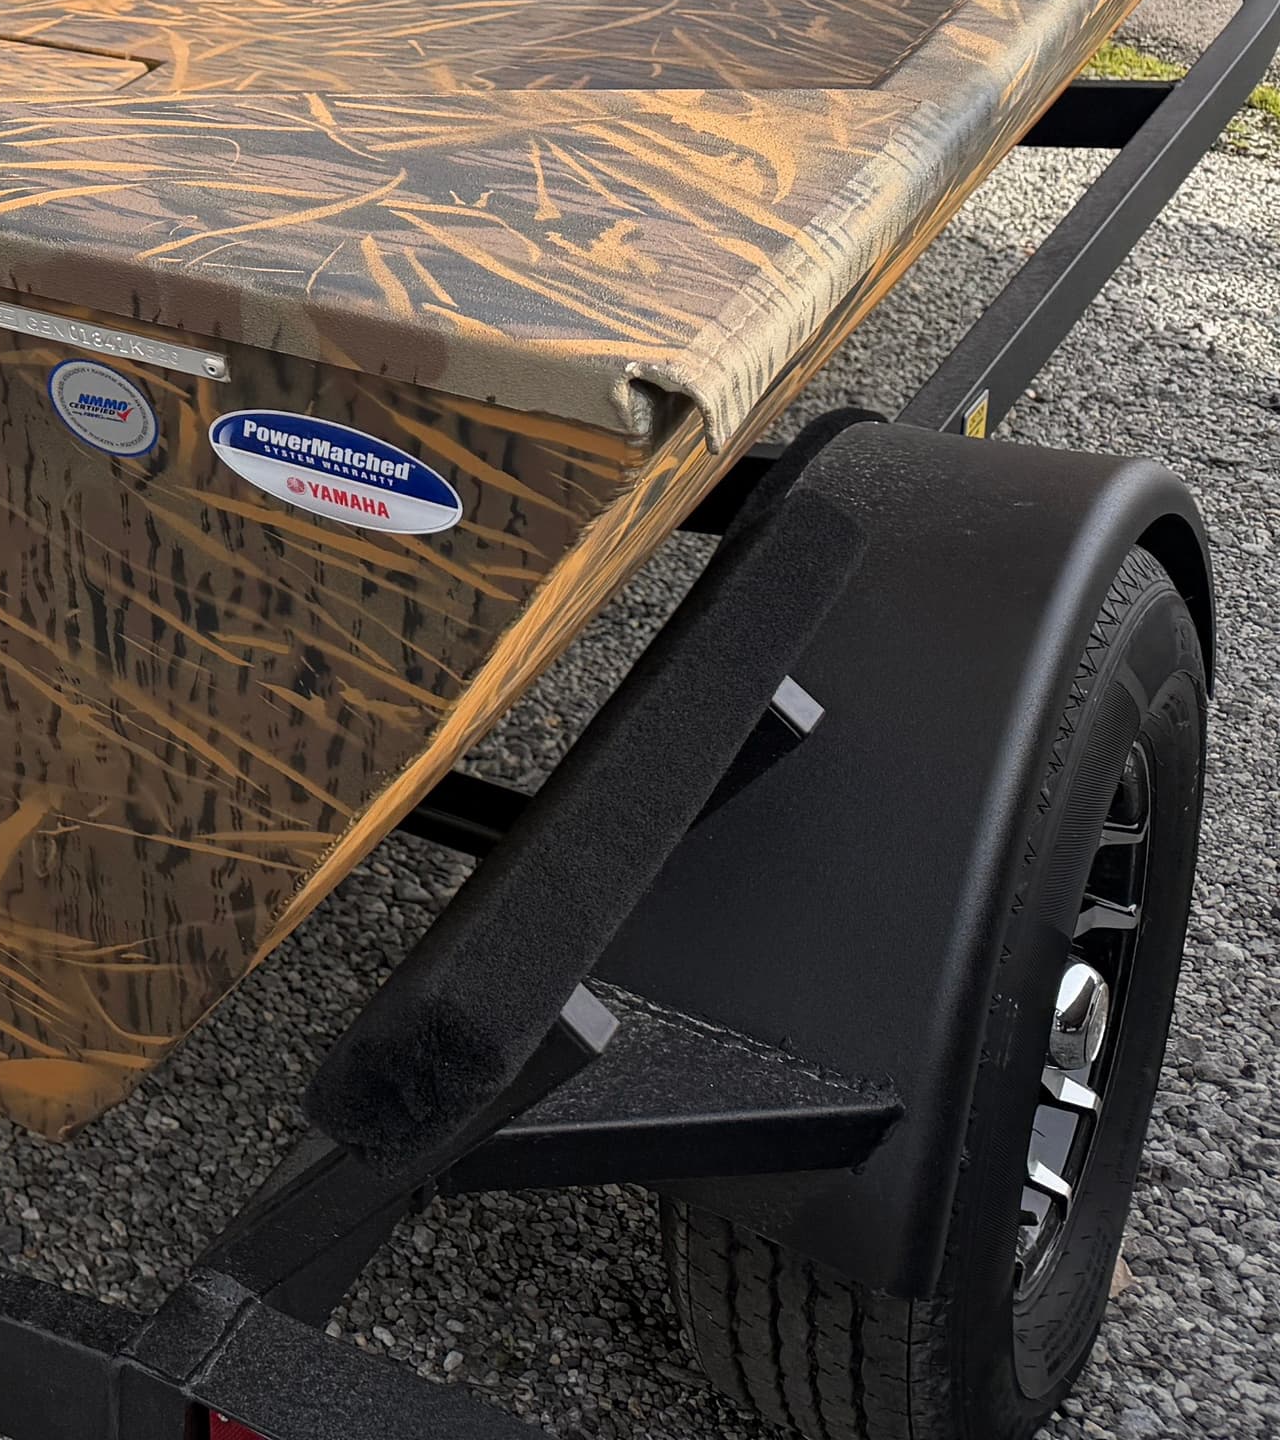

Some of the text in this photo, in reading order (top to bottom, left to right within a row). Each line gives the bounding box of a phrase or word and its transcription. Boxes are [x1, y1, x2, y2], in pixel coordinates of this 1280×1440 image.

[69, 402, 116, 416] CERTIFIED
[242, 420, 411, 481] PowerMatched
[264, 445, 394, 487] SYSTEM WARRANTY
[307, 481, 391, 520] YAMAHA
